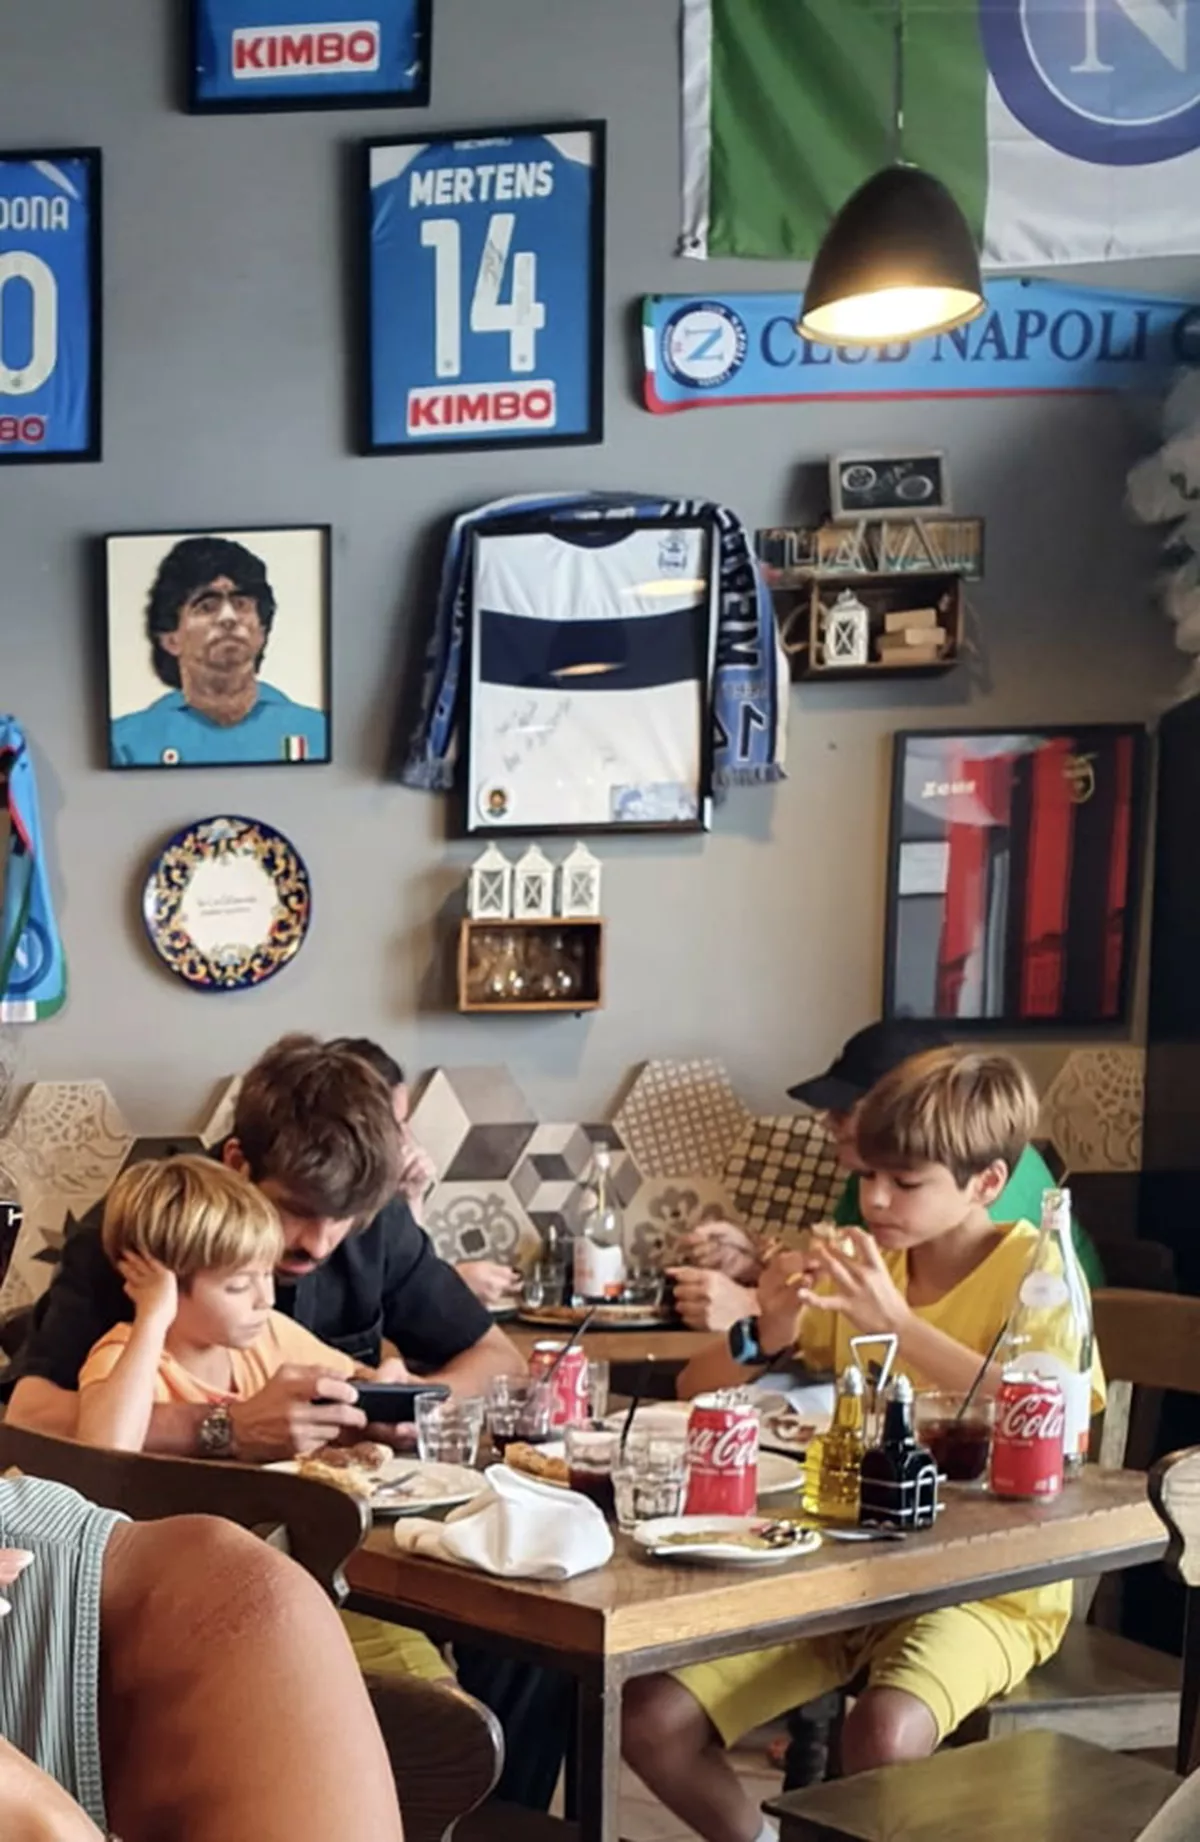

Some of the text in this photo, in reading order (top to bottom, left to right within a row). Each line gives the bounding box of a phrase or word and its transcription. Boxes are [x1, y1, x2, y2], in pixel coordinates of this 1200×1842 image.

[234, 29, 376, 70] KIMBO
[408, 160, 555, 209] MERTENS
[420, 212, 546, 379] 14
[932, 308, 1152, 363] NAPOLI
[409, 388, 553, 428] KIMBO
